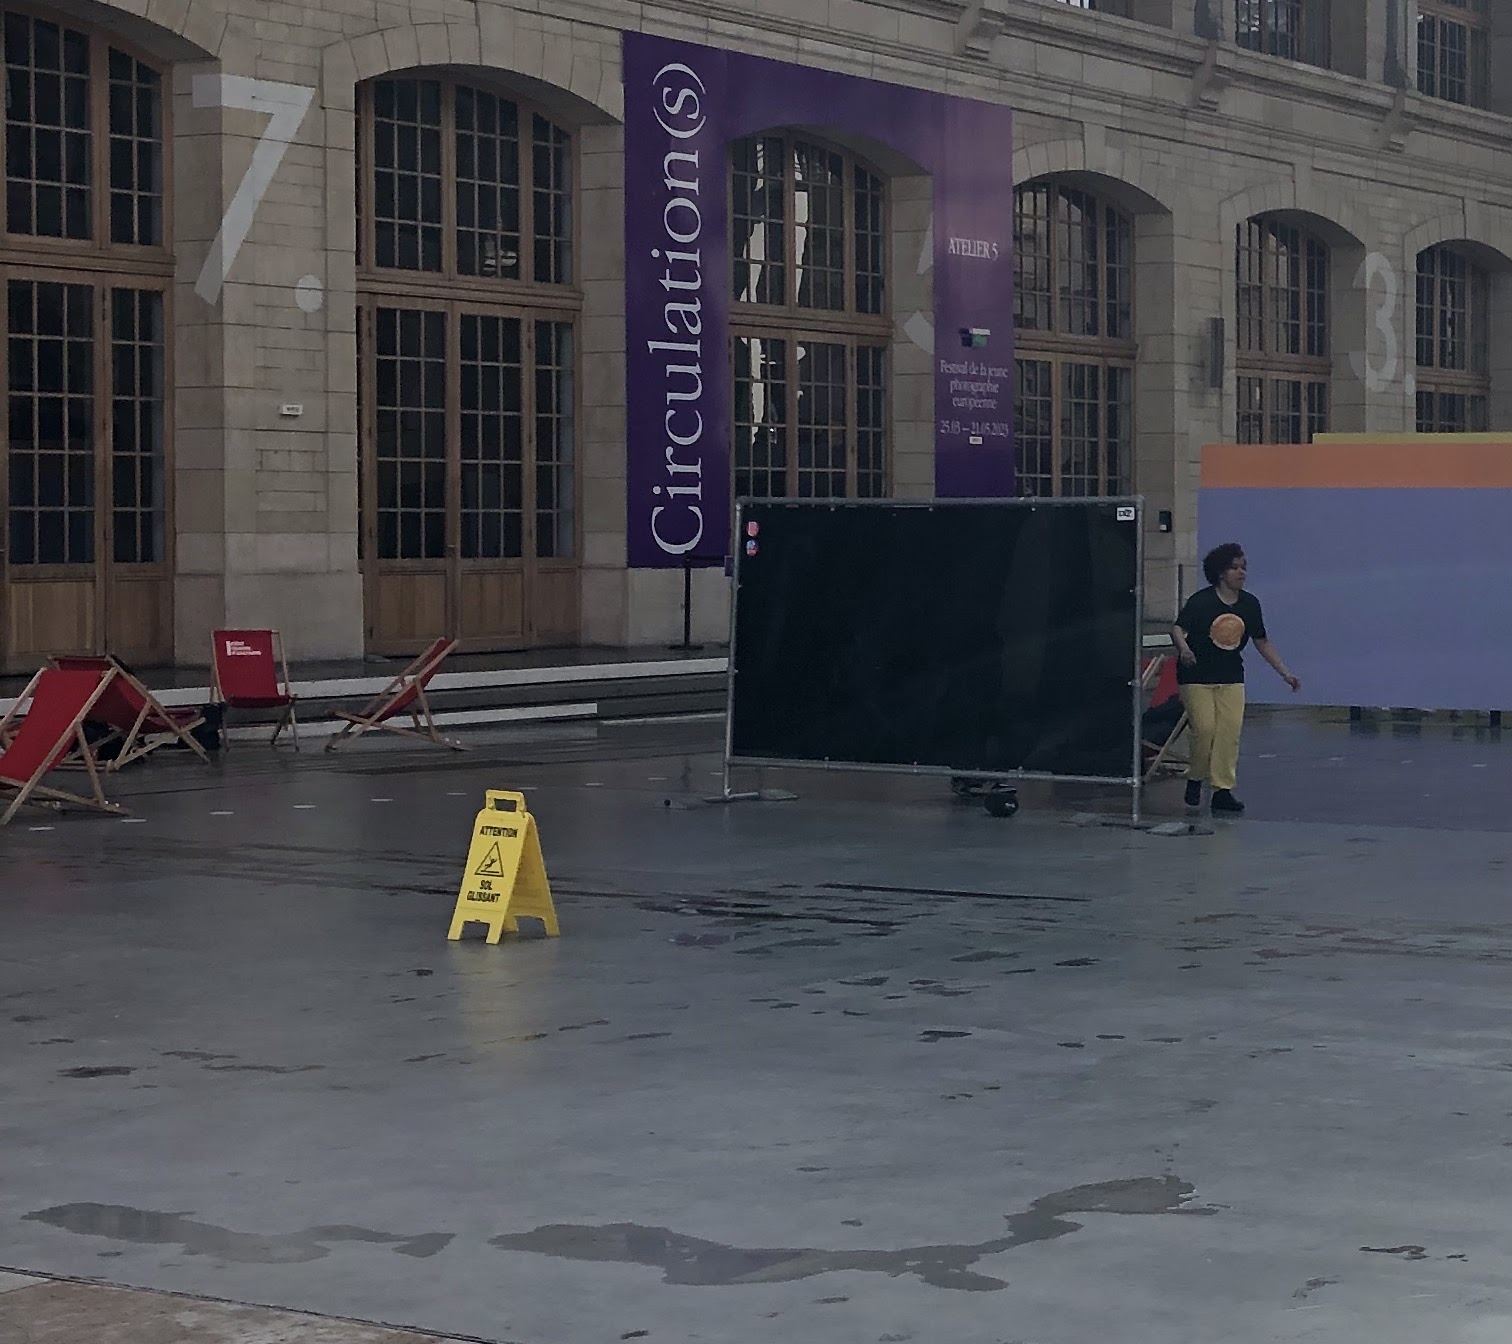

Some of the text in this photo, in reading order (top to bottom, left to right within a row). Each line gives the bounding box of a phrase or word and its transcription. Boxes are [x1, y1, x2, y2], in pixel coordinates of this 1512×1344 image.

[948, 237, 999, 262] ATELIER 5
[648, 61, 708, 556] Circulation(s)
[969, 361, 980, 375] de
[479, 825, 519, 838] ATTENTION
[480, 879, 493, 891] SOL
[466, 890, 501, 903] GLISSANT
